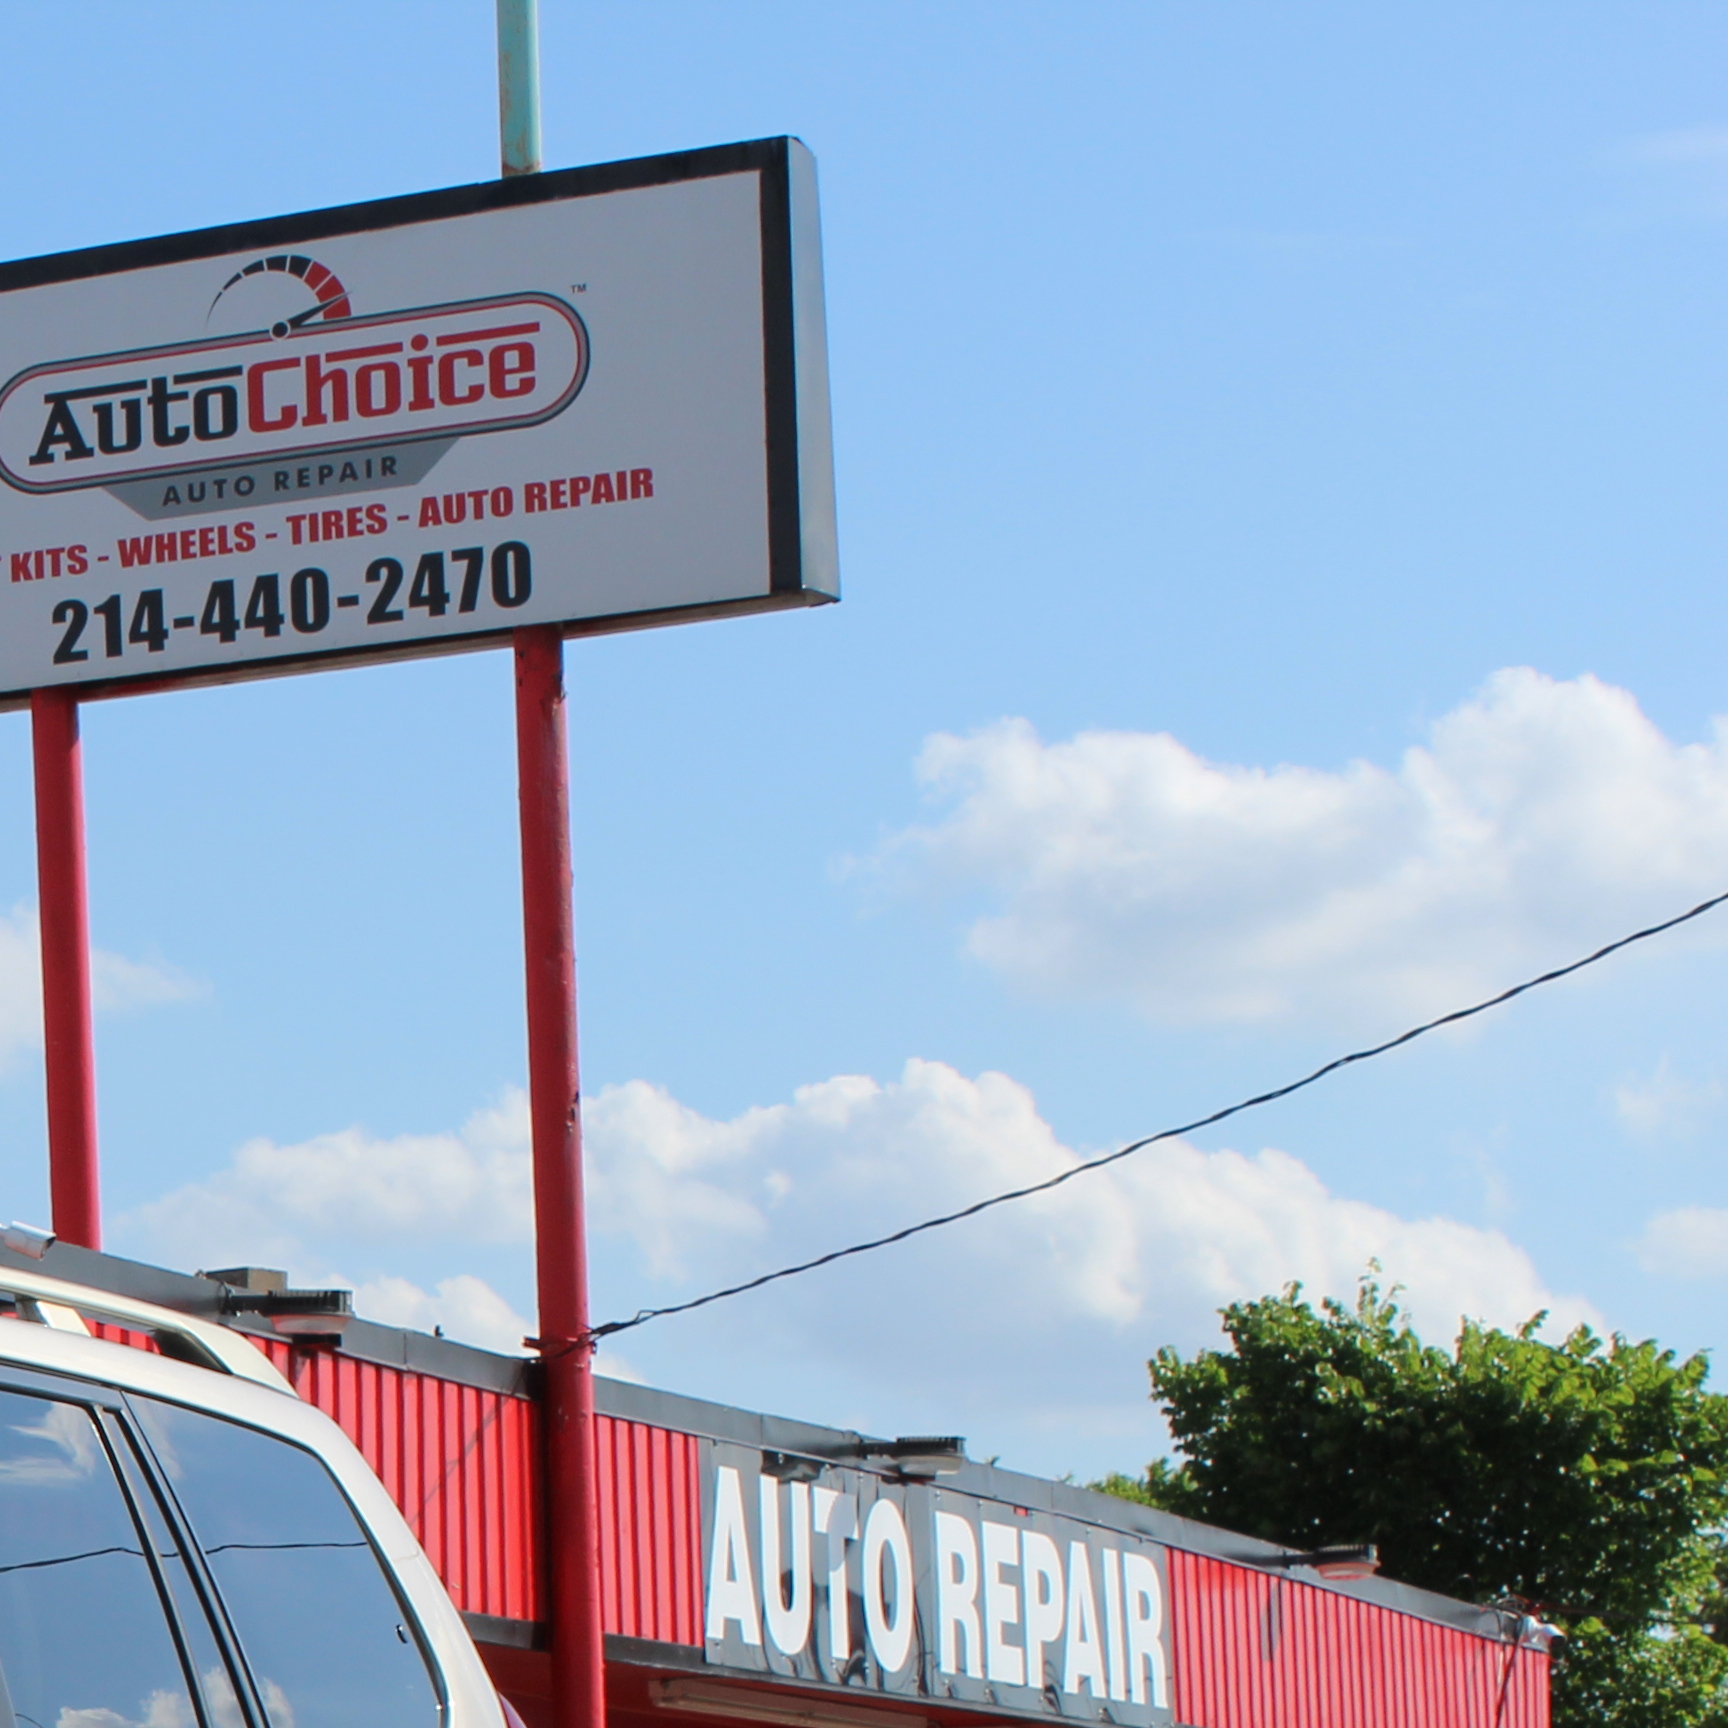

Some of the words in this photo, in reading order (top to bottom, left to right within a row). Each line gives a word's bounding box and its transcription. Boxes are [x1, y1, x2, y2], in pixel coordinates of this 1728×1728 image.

[29, 322, 541, 466] AutoChoice
[10, 545, 89, 583] KITS
[117, 521, 257, 568] WHEELS
[286, 503, 388, 545] TIRES
[418, 486, 514, 528] AUTO
[524, 467, 654, 514] REPAIR
[161, 475, 256, 507] AUTO
[273, 456, 398, 492] REPAIR
[51, 540, 532, 665] 214-440-2470
[705, 1465, 915, 1674] AUTO
[934, 1509, 1169, 1709] REPAIR
